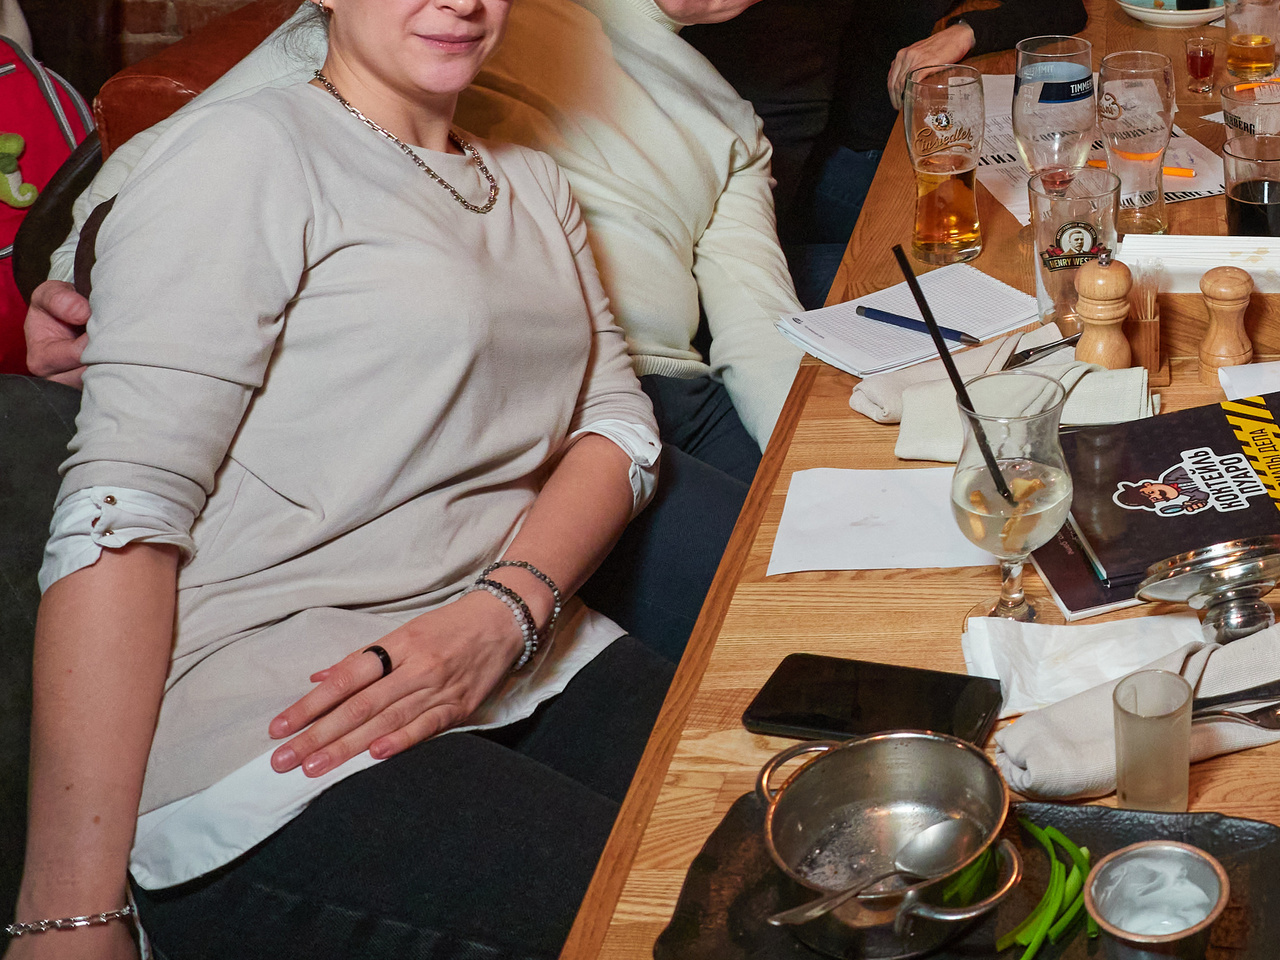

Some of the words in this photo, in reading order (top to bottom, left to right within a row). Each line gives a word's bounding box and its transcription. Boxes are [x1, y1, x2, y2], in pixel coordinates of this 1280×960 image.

[1250, 427, 1279, 453] ДЕЛА
[1188, 450, 1245, 510] КОКТЕЙЛЬ
[1219, 456, 1264, 495] ПУАРО
